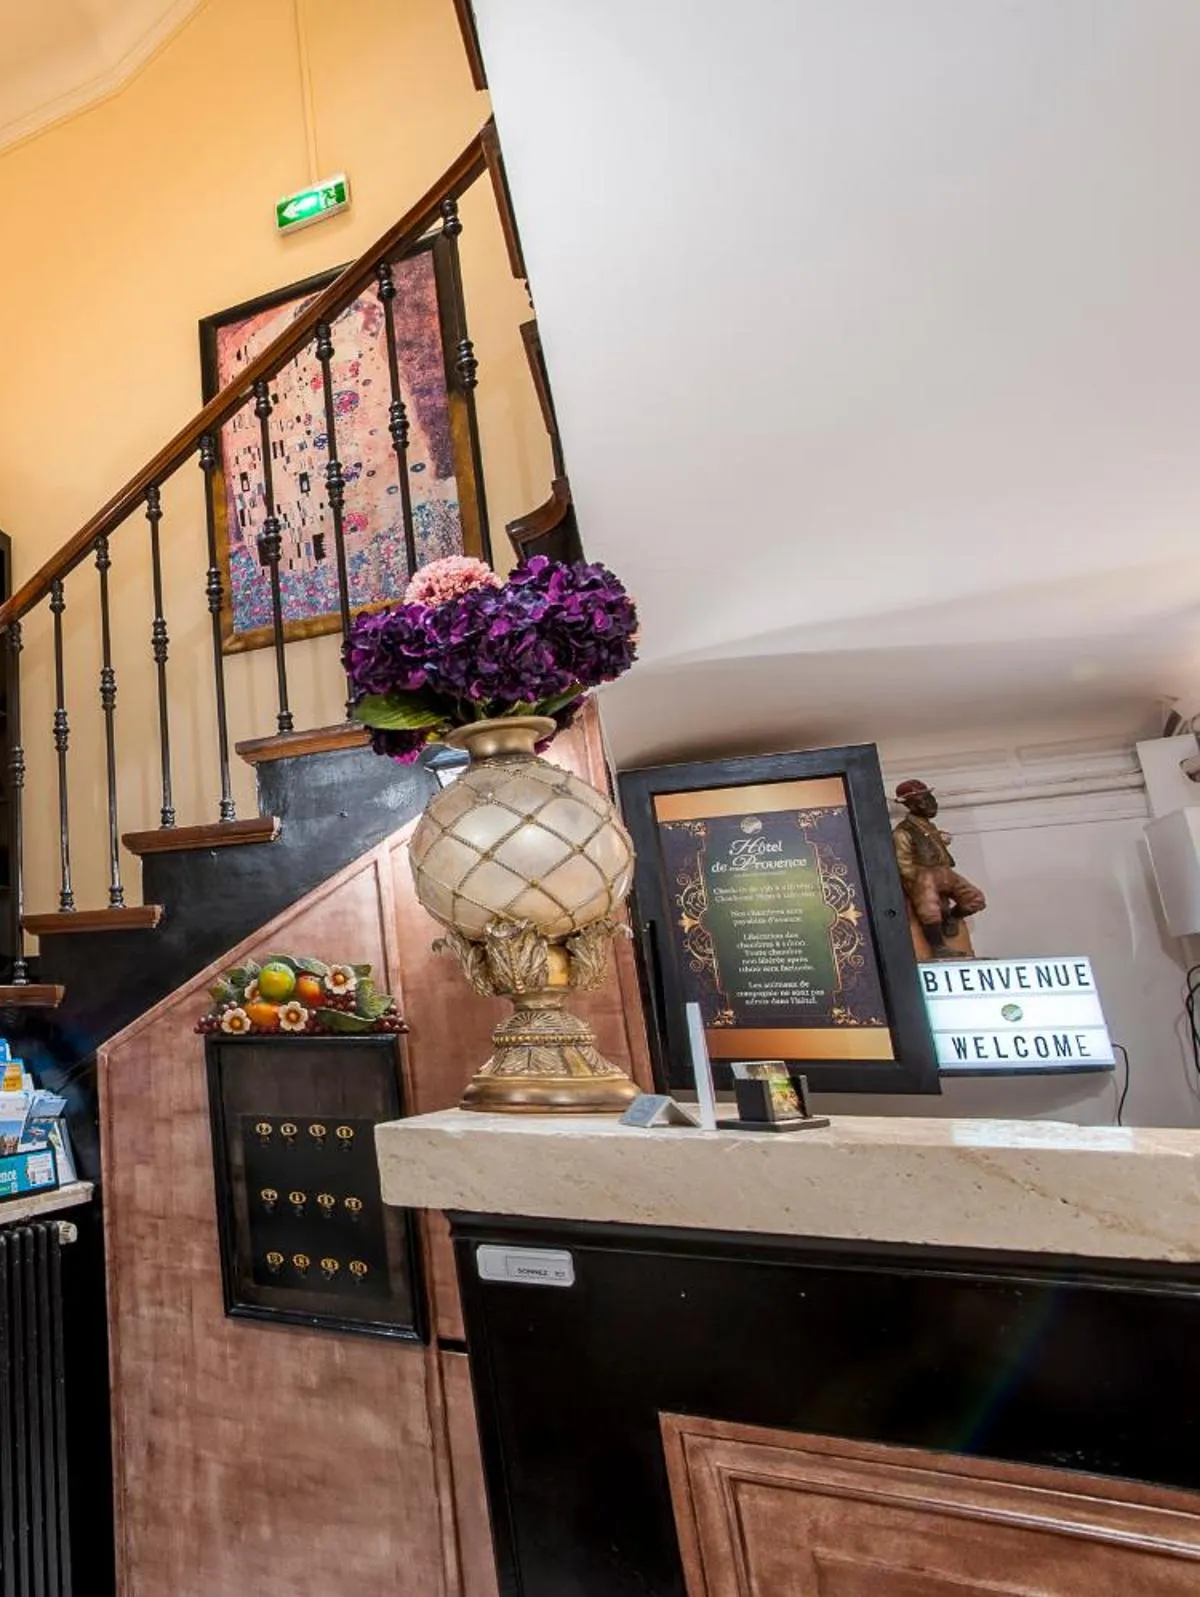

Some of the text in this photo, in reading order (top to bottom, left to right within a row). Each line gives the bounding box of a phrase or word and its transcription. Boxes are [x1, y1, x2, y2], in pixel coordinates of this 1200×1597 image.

[729, 836, 783, 855] Hôtel
[711, 854, 807, 873] de Provence
[922, 963, 1090, 993] BIENVENUE
[952, 1034, 1091, 1060] WELCOME
